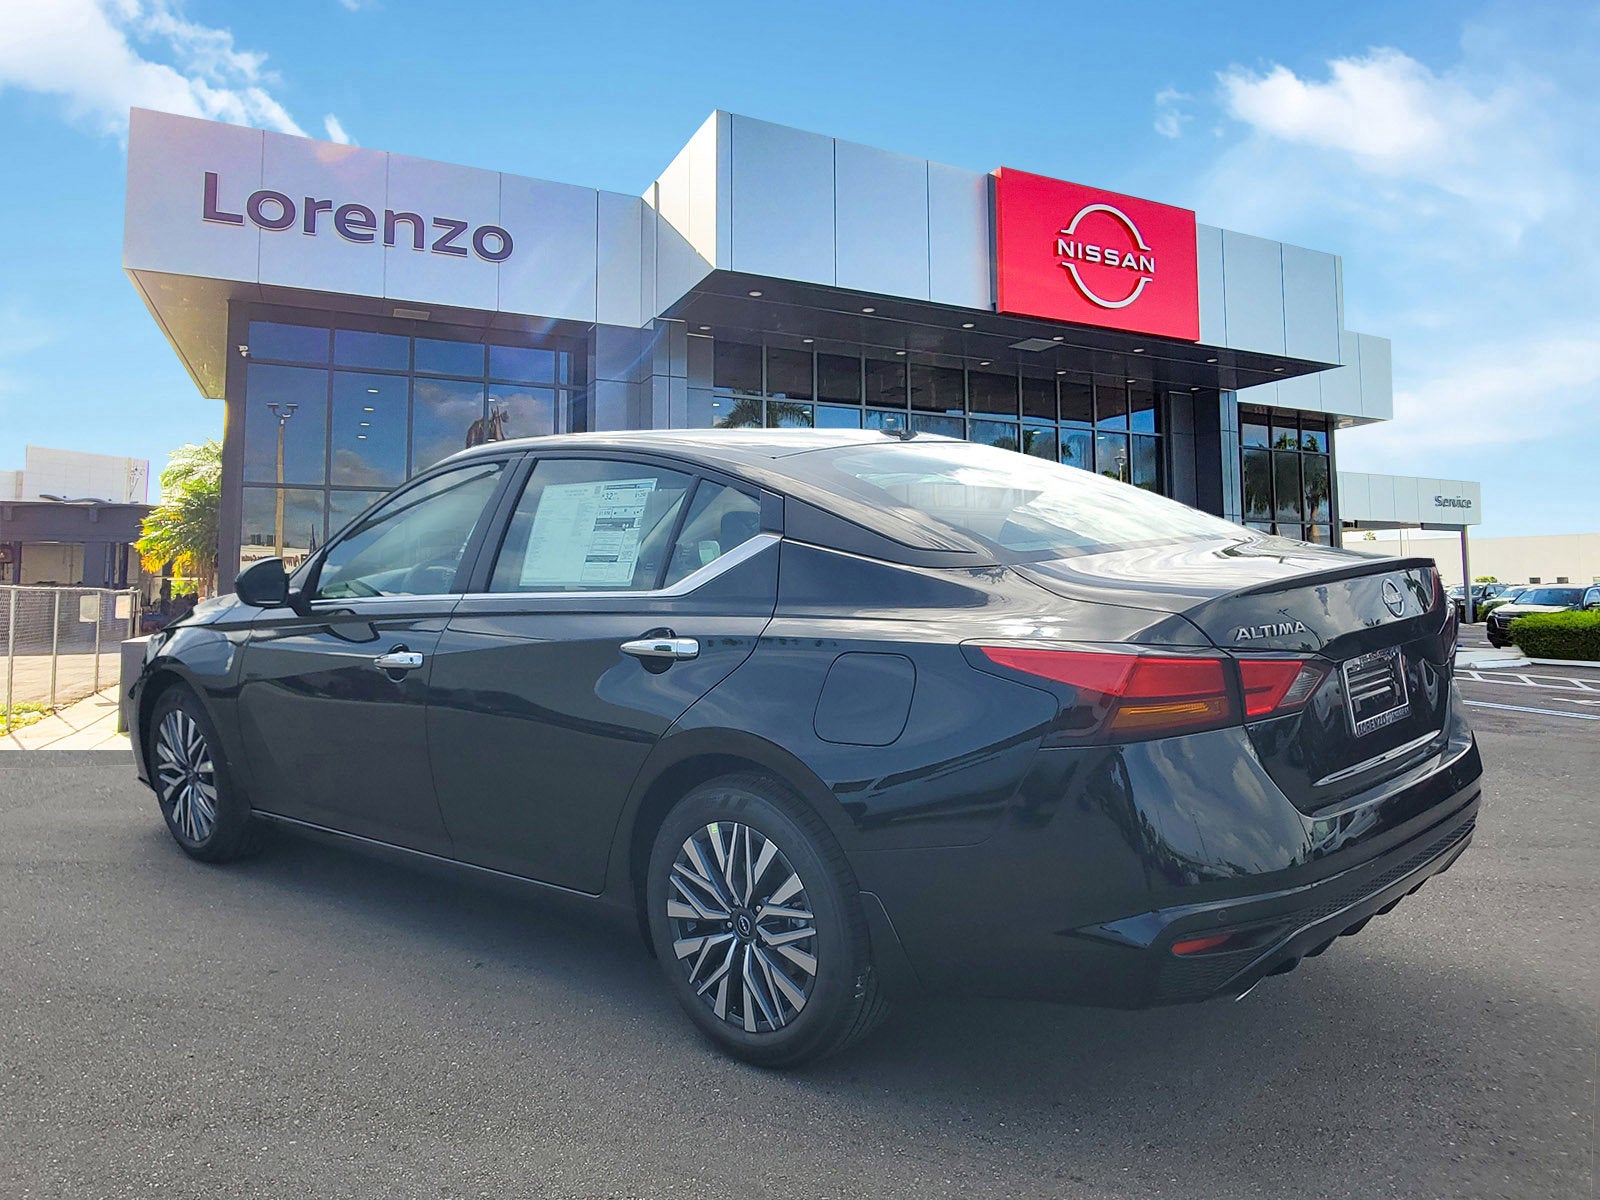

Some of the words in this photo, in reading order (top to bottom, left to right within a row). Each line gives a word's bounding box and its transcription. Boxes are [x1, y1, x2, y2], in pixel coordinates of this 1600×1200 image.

[203, 170, 514, 262] Lorenzo
[1057, 238, 1155, 273] NISSAN
[1434, 495, 1472, 508] Service
[1235, 621, 1306, 641] ALTIMA
